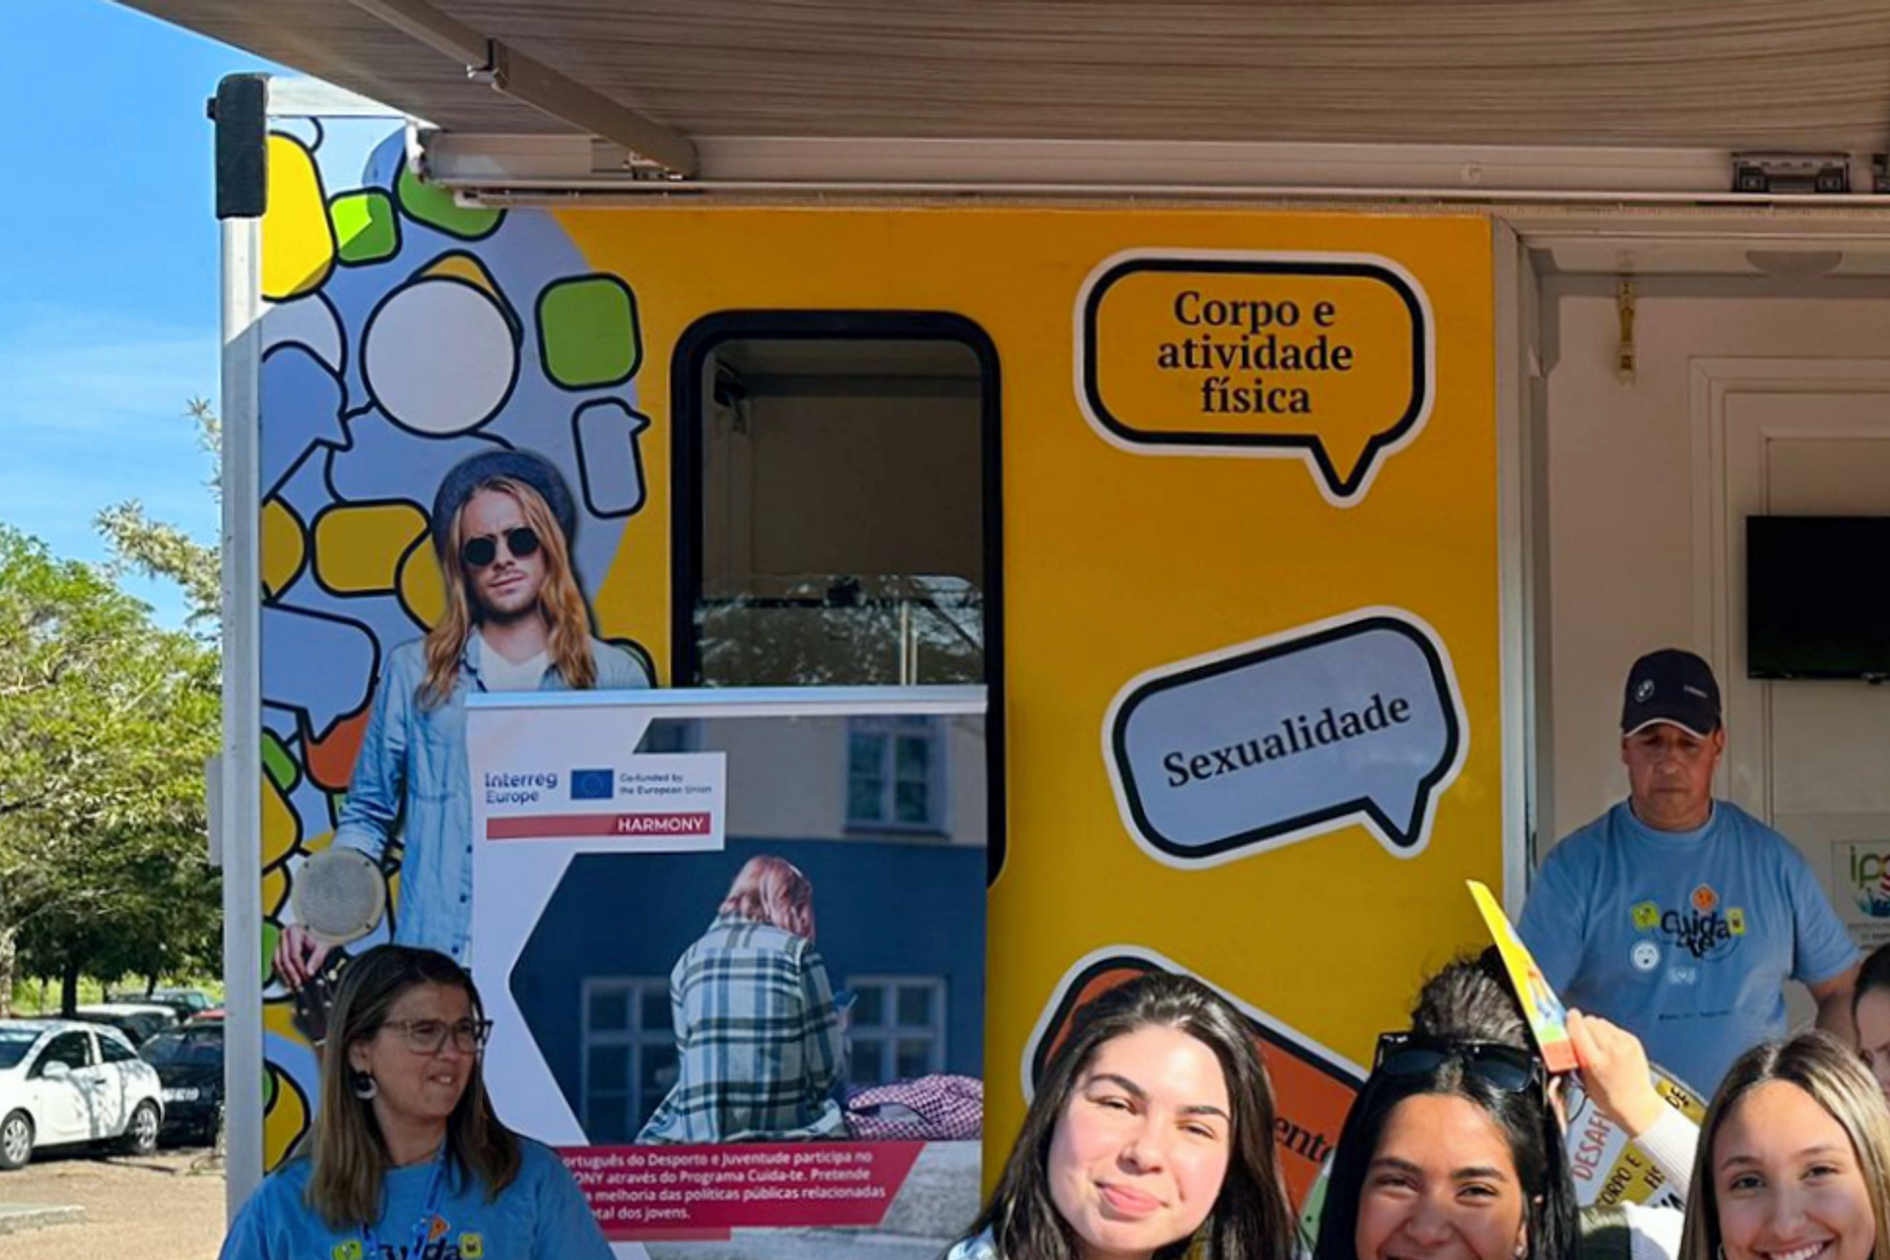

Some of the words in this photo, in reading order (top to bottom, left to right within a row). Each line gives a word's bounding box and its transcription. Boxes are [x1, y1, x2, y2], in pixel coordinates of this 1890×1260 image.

[1173, 291, 1300, 335] Corpo
[1313, 300, 1336, 327] e
[1157, 334, 1354, 371] atividade
[1200, 377, 1312, 414] física
[1162, 692, 1411, 788] Sexualidade
[485, 772, 557, 789] Interreg
[486, 790, 540, 805] Europe
[637, 785, 683, 796] European
[617, 817, 704, 832] HARMONY
[1661, 910, 1732, 939] Cuida
[563, 1153, 625, 1169] ortuguês
[628, 1153, 645, 1167] do
[648, 1153, 709, 1169] Desporto
[711, 1155, 720, 1165] e
[721, 1151, 791, 1168] Juventude
[794, 1150, 851, 1167] participa
[854, 1152, 873, 1163] no
[606, 1170, 656, 1184] através
[659, 1170, 677, 1184] do
[680, 1170, 744, 1186] Programa
[747, 1168, 808, 1182] Cuida-te.
[810, 1167, 870, 1181] Pretende
[595, 1187, 657, 1200] melhoria
[660, 1186, 682, 1200] das
[685, 1185, 740, 1203] políticas
[742, 1184, 800, 1203] públicas
[802, 1184, 886, 1198] relacionadas
[618, 1205, 642, 1219] dos
[644, 1205, 690, 1222] jovens.
